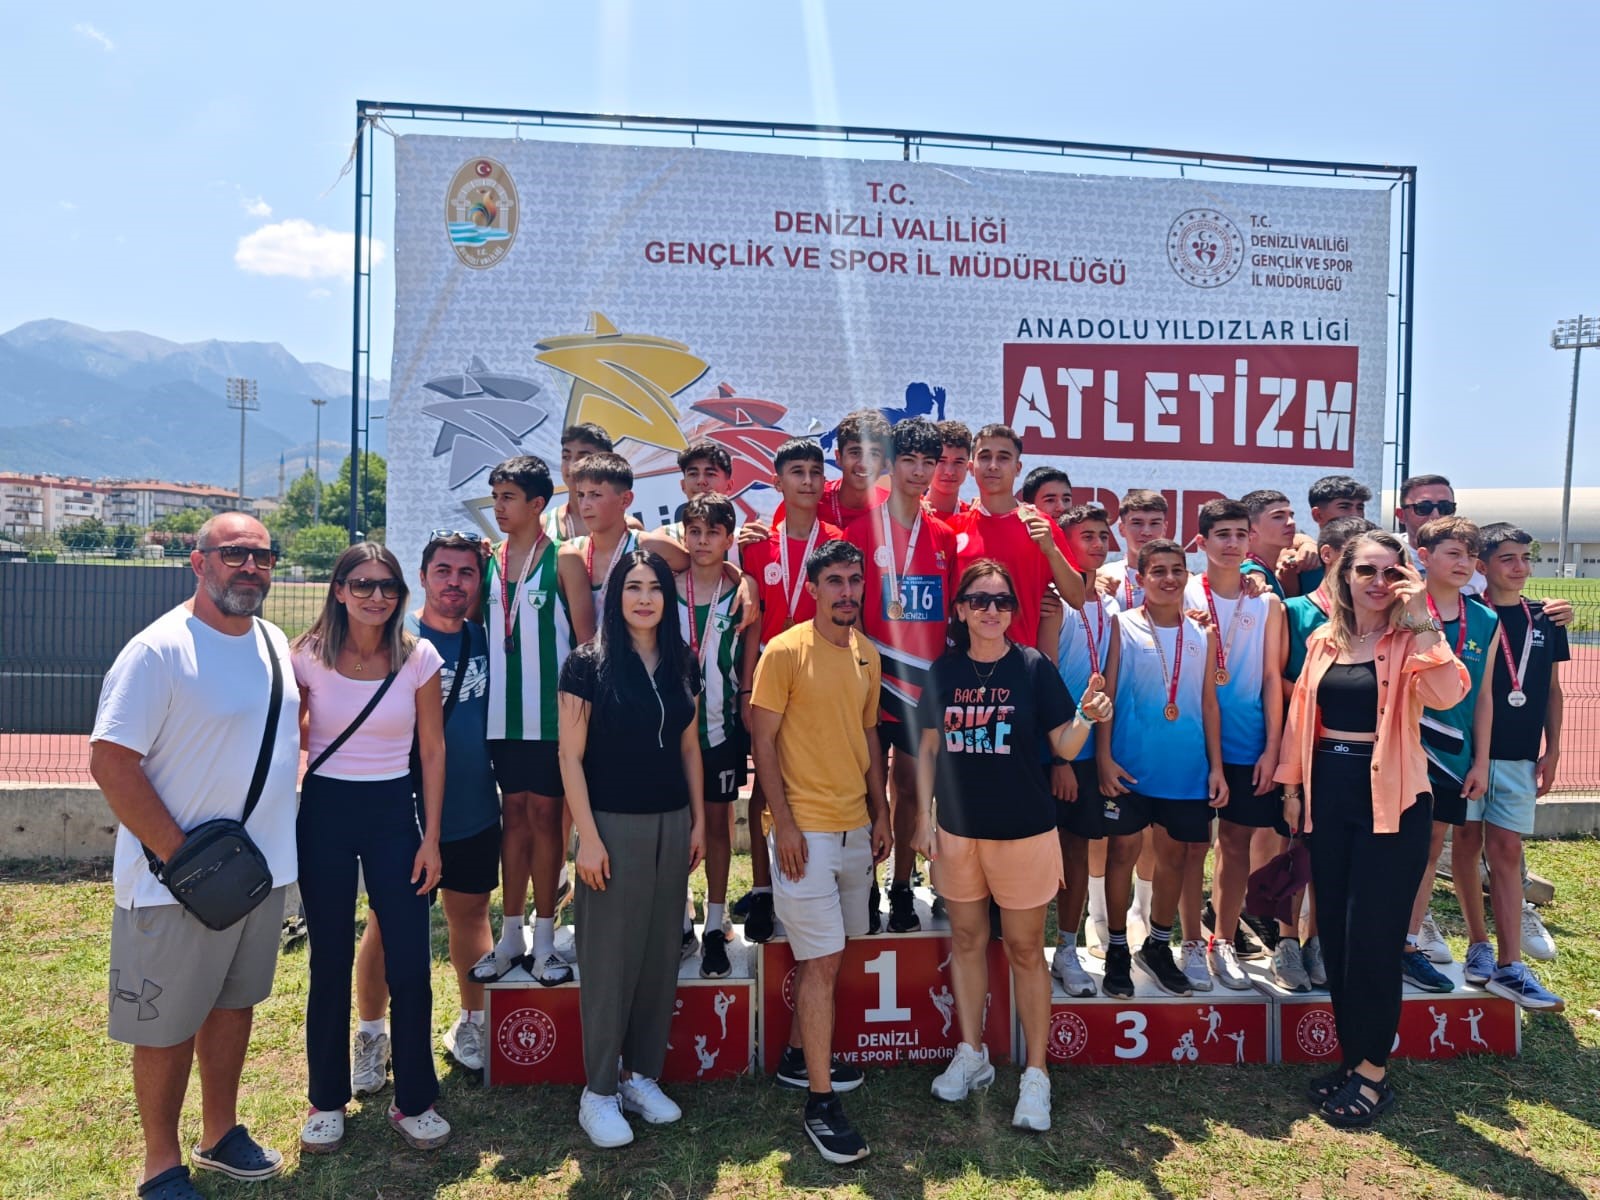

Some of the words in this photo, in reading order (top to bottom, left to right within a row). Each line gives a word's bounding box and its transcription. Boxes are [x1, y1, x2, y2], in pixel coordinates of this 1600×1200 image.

[866, 182, 914, 205] T.C.
[775, 208, 883, 238] DENİZLİ
[891, 215, 1007, 244] VALİLİĞİ
[1250, 215, 1272, 228] T.C.
[1251, 233, 1298, 249] DENİZLİ
[1300, 235, 1349, 252] VALİLİĞİ
[644, 239, 775, 271] GENÇLİK
[783, 246, 821, 269] VE
[829, 248, 908, 275] SPOR
[916, 248, 941, 276] İL
[949, 251, 1126, 286] MÜDÜRLÜĞÜ
[1251, 253, 1303, 271] GENÇLİK
[1305, 257, 1320, 270] VE
[1322, 258, 1353, 273] SPOR
[1251, 271, 1262, 287] İL
[1265, 272, 1342, 291] MÜDÜRLÜĞÜ
[1016, 317, 1149, 339] ANADOLU
[1156, 318, 1295, 340] YILDIZLAR
[1302, 317, 1350, 341] LİGİ
[1010, 358, 1353, 452] ATLETİZM
[954, 688, 984, 704] BACK
[718, 769, 736, 794] 17
[864, 950, 912, 1023] 1
[857, 1029, 919, 1047] DENİZLİ
[1114, 1010, 1149, 1059] 3
[843, 1052, 858, 1063] VE
[861, 1050, 893, 1062] SPOR
